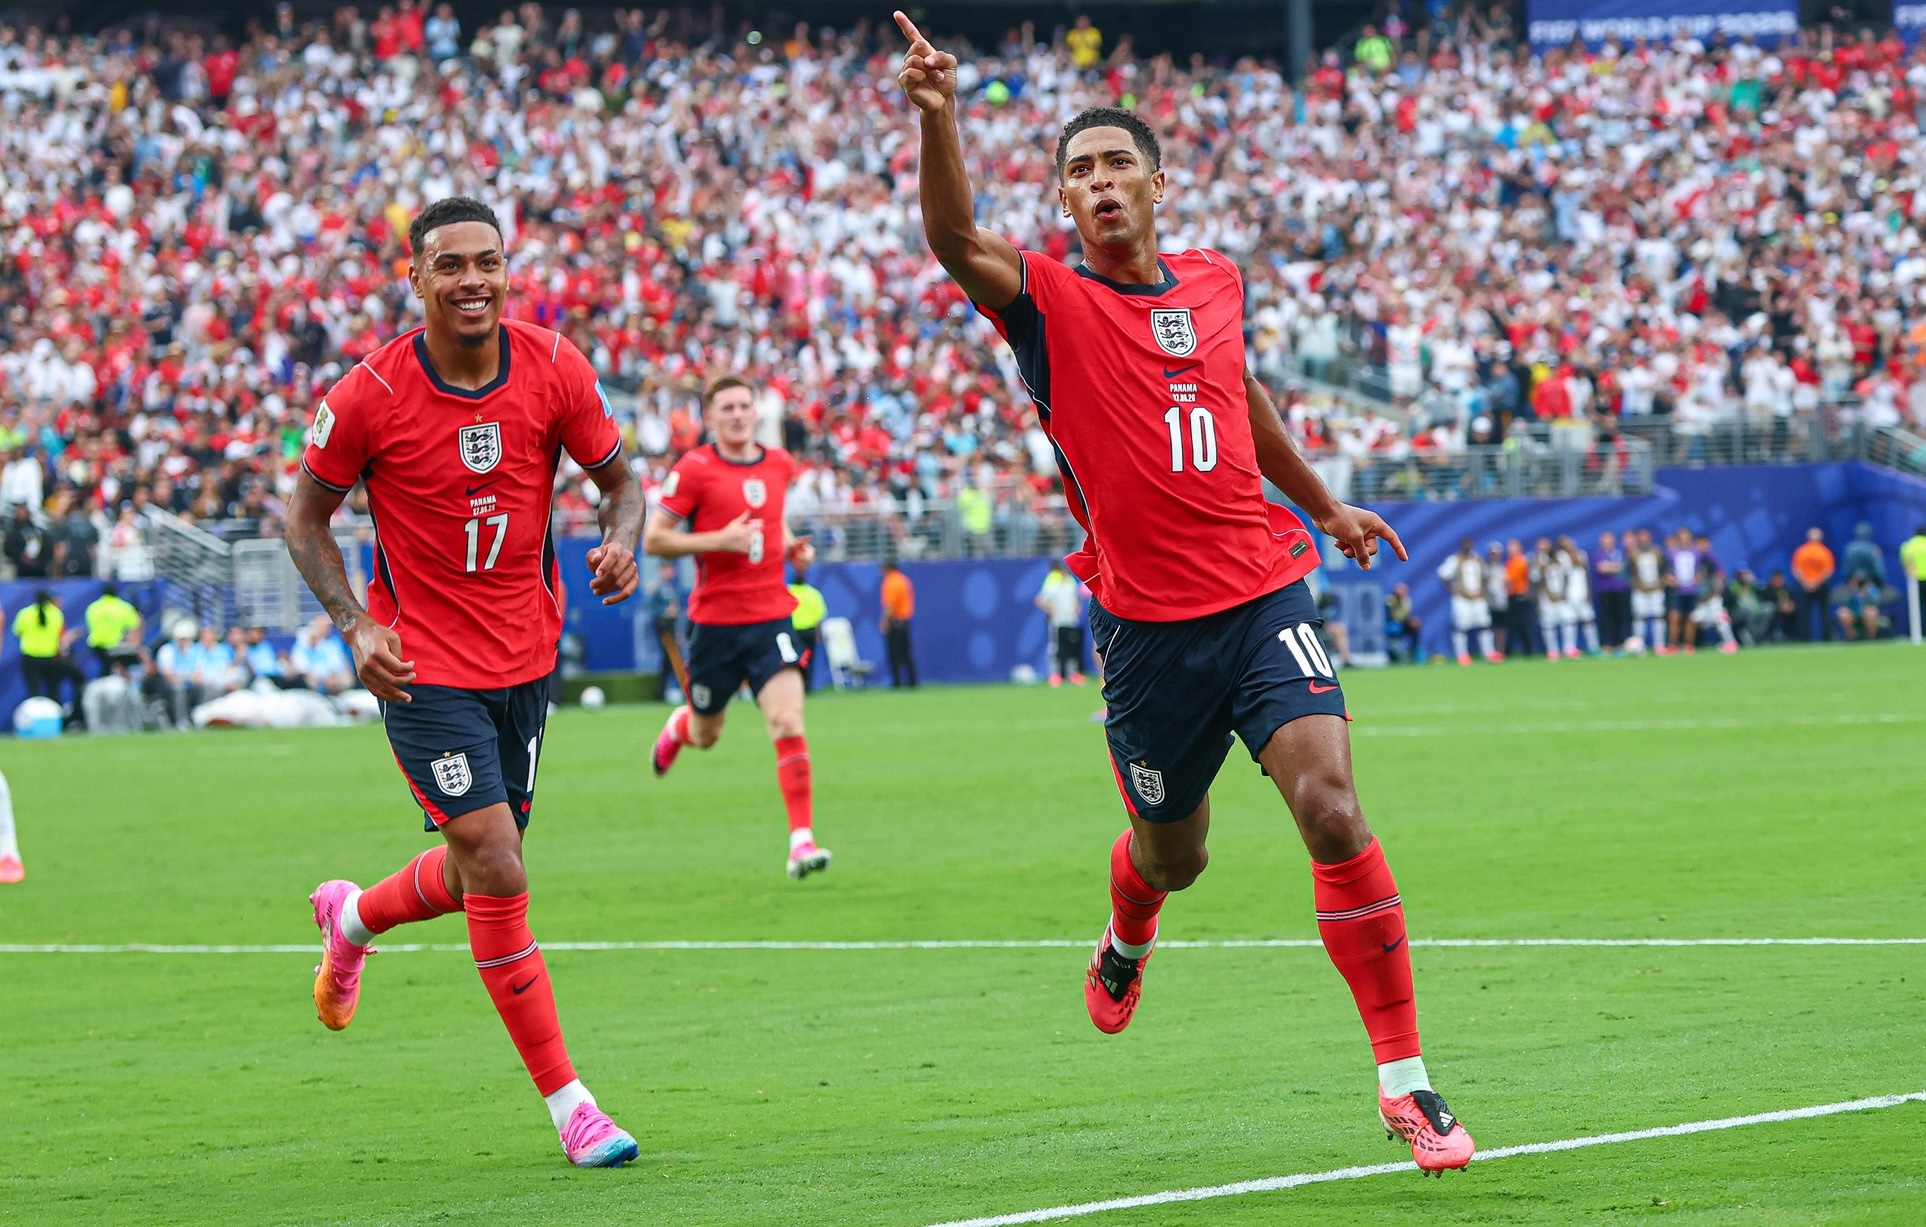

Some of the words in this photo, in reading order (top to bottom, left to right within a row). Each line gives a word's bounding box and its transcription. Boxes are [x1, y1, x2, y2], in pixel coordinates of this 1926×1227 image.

[1169, 383, 1198, 393] PANAMA
[1164, 406, 1218, 472] 10
[470, 494, 497, 509] PANAMA
[464, 512, 509, 573] 17
[1278, 622, 1334, 678] 10
[527, 727, 543, 793] 1
